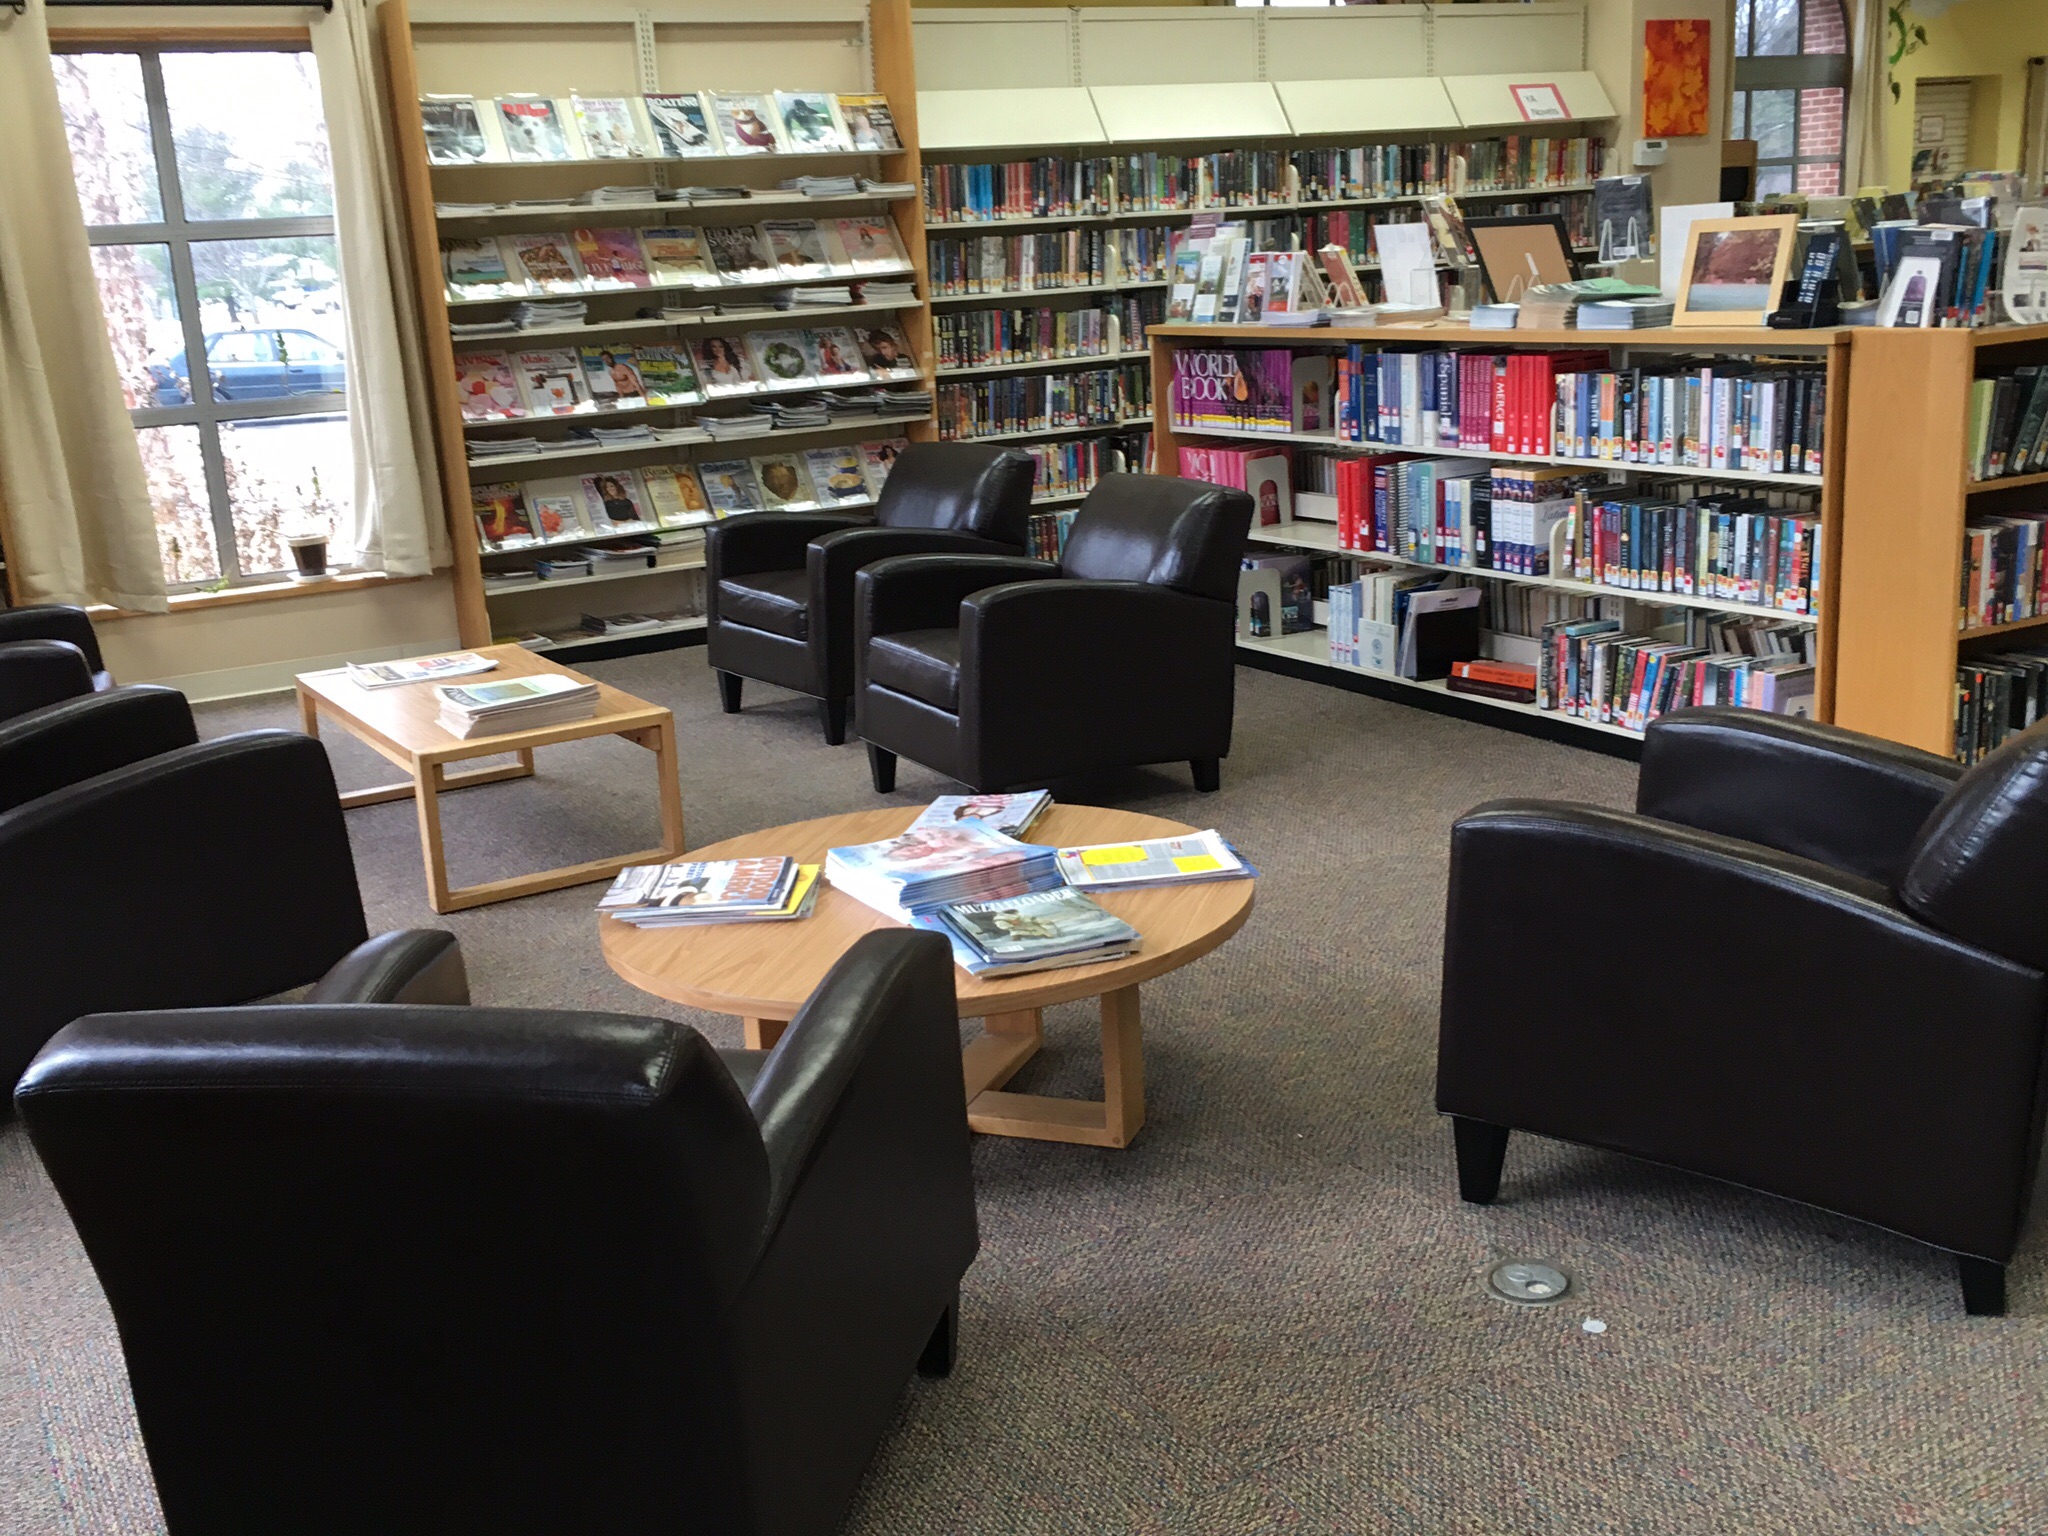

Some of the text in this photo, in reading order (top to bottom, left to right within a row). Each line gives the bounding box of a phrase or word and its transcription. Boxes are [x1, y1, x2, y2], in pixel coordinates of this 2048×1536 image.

[1174, 352, 1240, 377] WORLD
[1181, 376, 1228, 400] BOOK
[720, 859, 752, 900] AMERICA
[748, 856, 784, 901] OUTDOOR
[952, 887, 1078, 914] MUZZLELOADER
